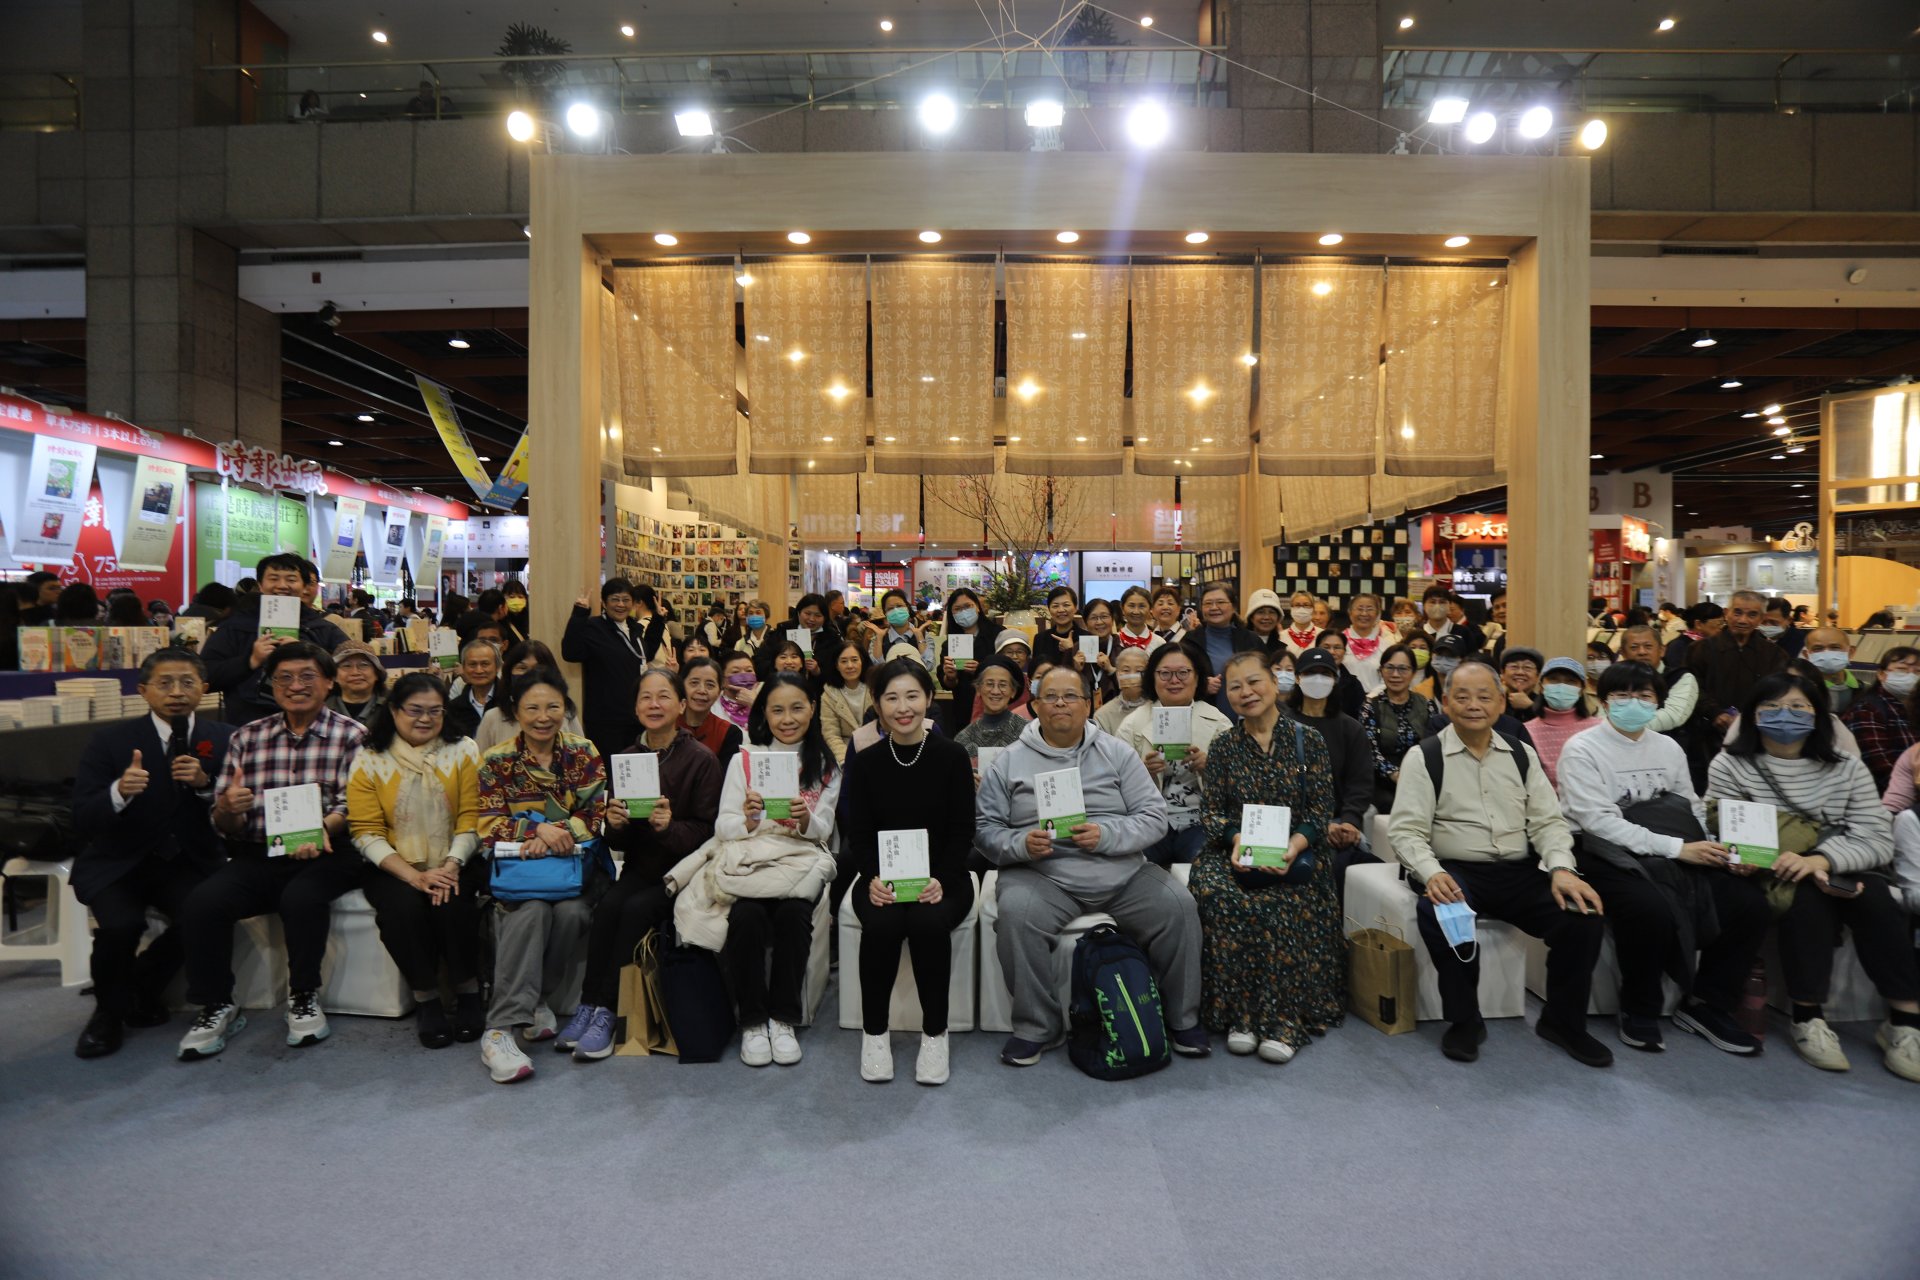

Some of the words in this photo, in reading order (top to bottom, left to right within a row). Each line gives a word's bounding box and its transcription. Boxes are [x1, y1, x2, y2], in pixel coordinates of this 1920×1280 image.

[221, 442, 325, 494] 時報出版
[1632, 482, 1652, 508] B
